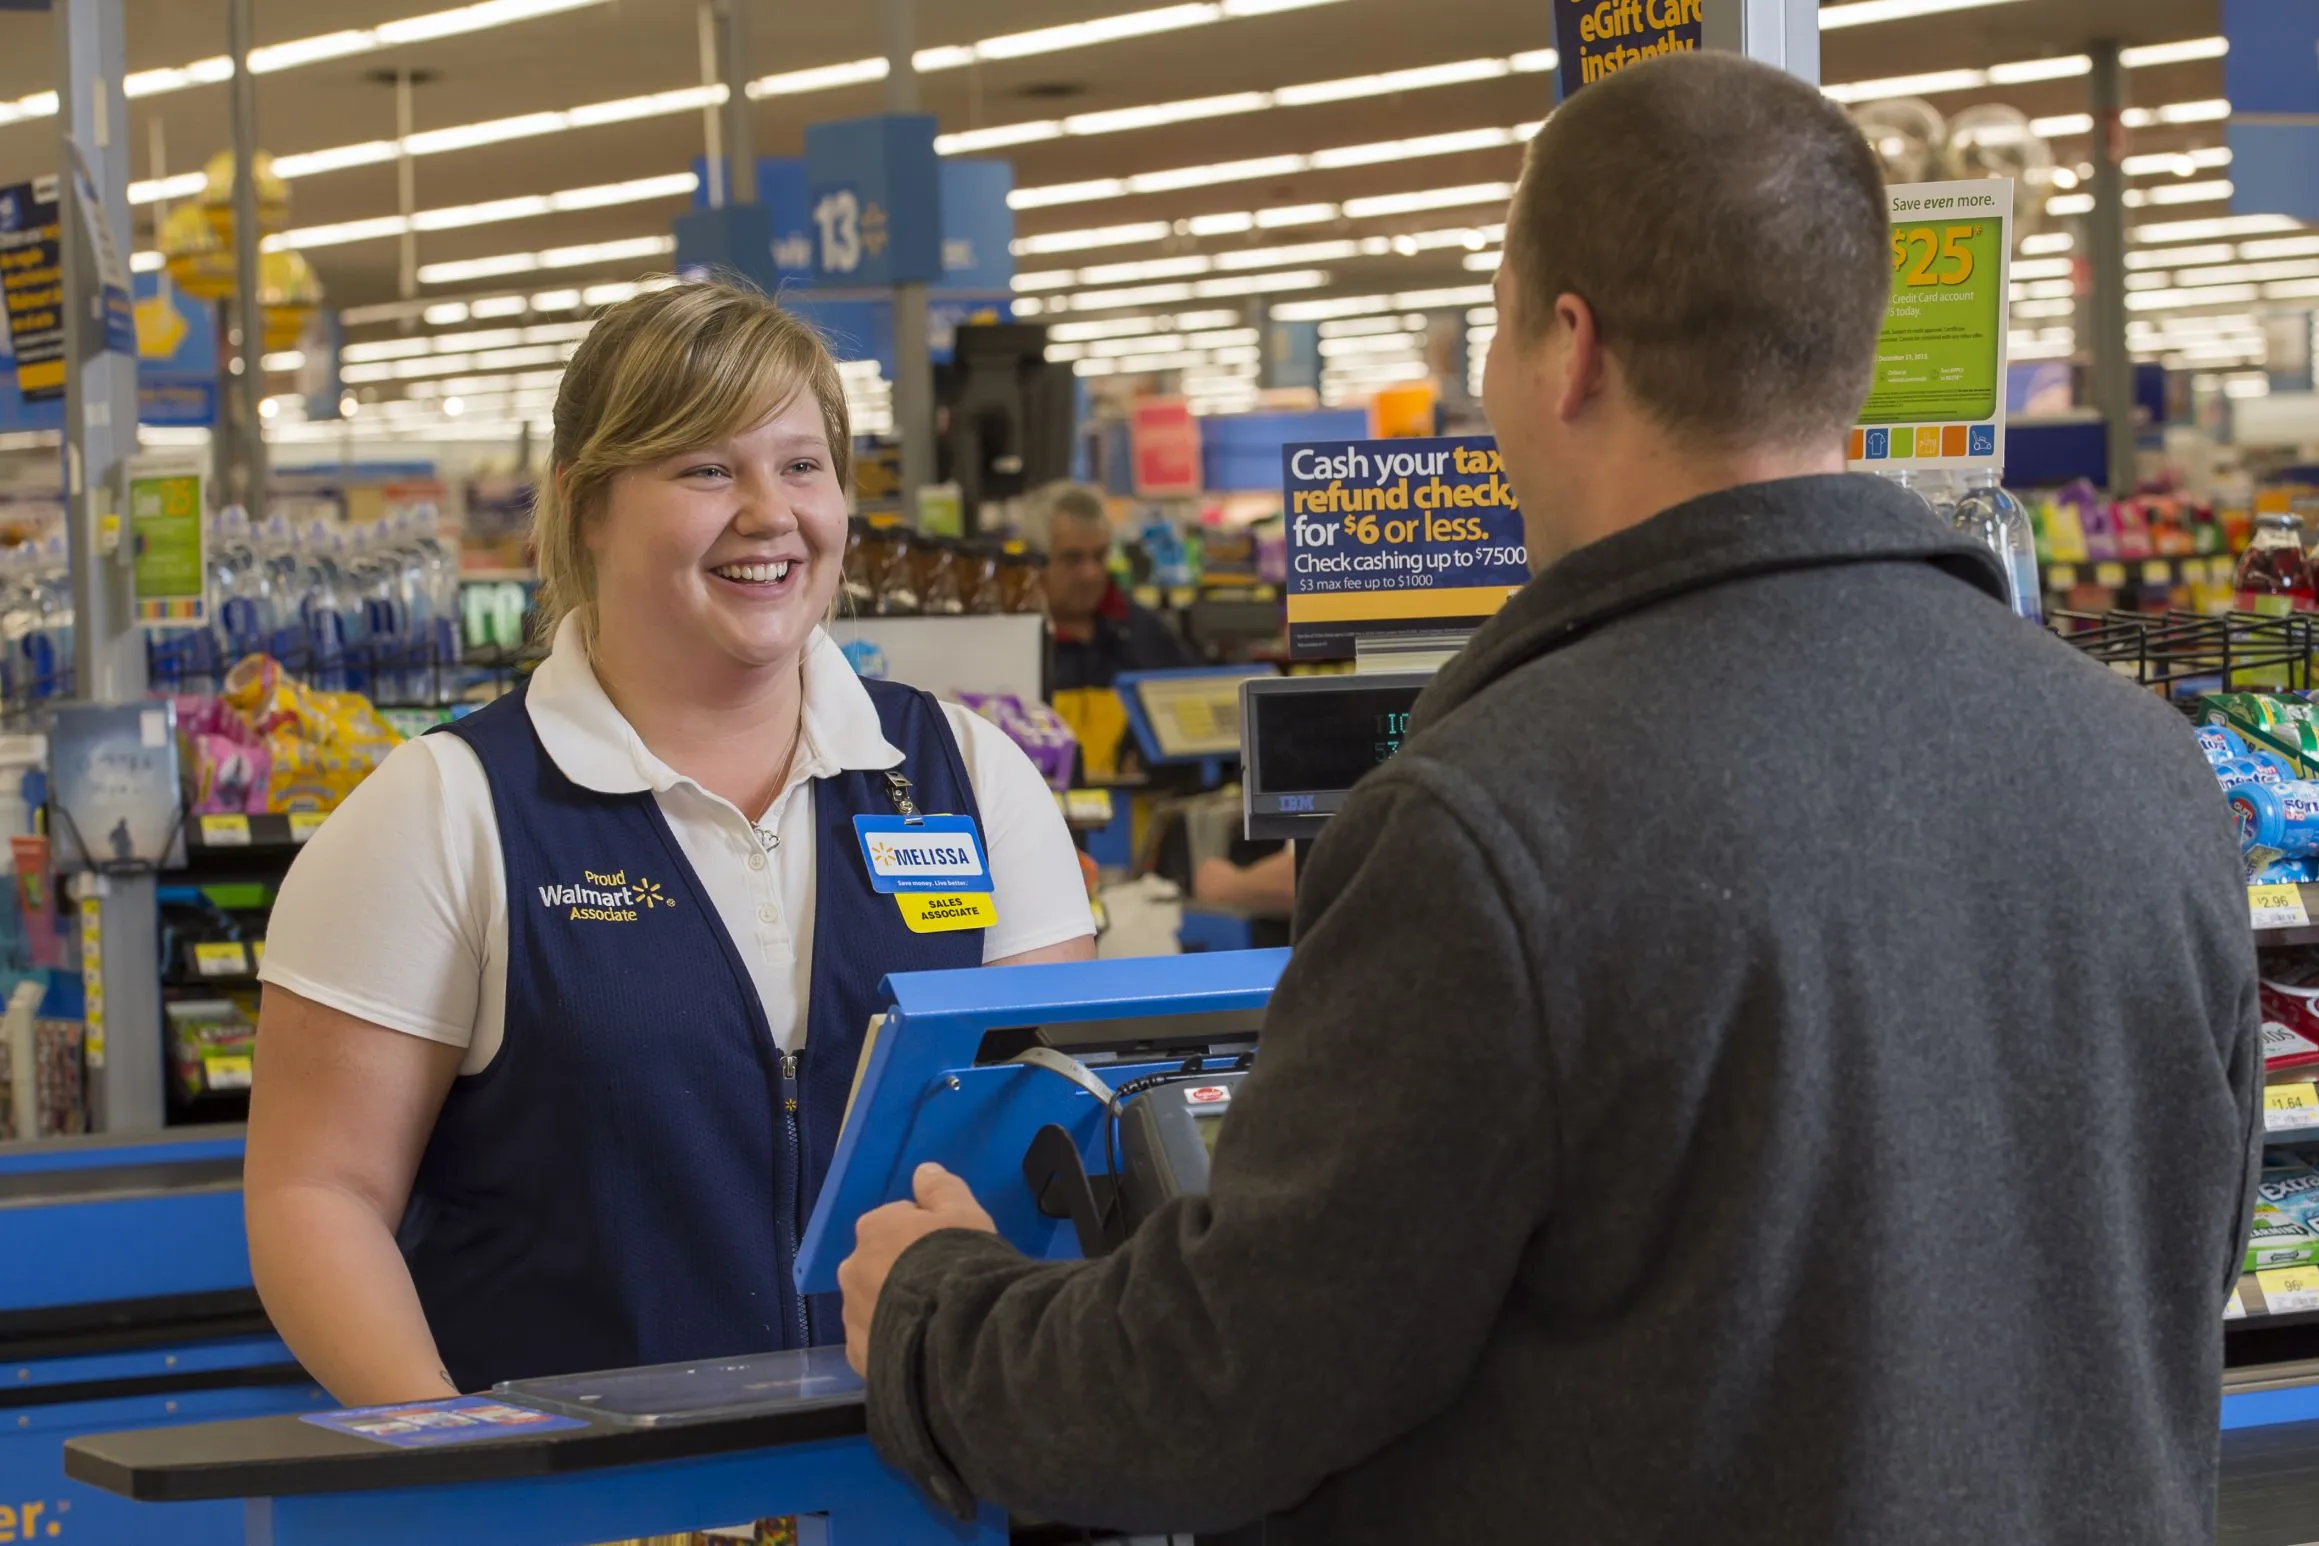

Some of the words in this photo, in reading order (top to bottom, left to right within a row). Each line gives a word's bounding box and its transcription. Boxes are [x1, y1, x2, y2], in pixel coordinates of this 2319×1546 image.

[1580, 0, 1644, 42] eGift
[1892, 197, 1921, 212] Save
[1923, 197, 1954, 209] even
[1957, 195, 1995, 207] more.
[1892, 293, 1918, 304] Credit
[1918, 292, 1938, 303] Card
[1939, 291, 1974, 301] account
[1896, 307, 1921, 318] today.
[1291, 446, 1369, 480] Cash
[1374, 451, 1449, 486] your
[1453, 446, 1505, 474] tax
[1292, 477, 1409, 514] refund
[1293, 515, 1339, 547] for
[1344, 514, 1380, 545] $6
[1384, 519, 1419, 544] or
[1425, 510, 1489, 542] less.
[1294, 553, 1351, 573] Check
[1353, 549, 1423, 574] cashing
[1426, 553, 1452, 572] up
[1453, 551, 1473, 567] to
[1475, 546, 1528, 566] $7500
[1300, 578, 1314, 593] $3
[1316, 579, 1341, 591] max
[1344, 577, 1362, 590] fee
[1363, 579, 1381, 592] up
[1383, 576, 1395, 588] to
[1398, 574, 1433, 589] $1000
[1279, 795, 1315, 812] IBM
[894, 847, 970, 866] MELISSA
[584, 869, 626, 886] Proud
[538, 883, 634, 907] Walmart
[928, 897, 963, 909] SALES
[2257, 895, 2289, 908] $2.96
[570, 906, 638, 922] Associate
[921, 907, 980, 920] ASSOCIATE
[2272, 1096, 2303, 1111] $1.64
[2258, 1175, 2319, 1202] Extra
